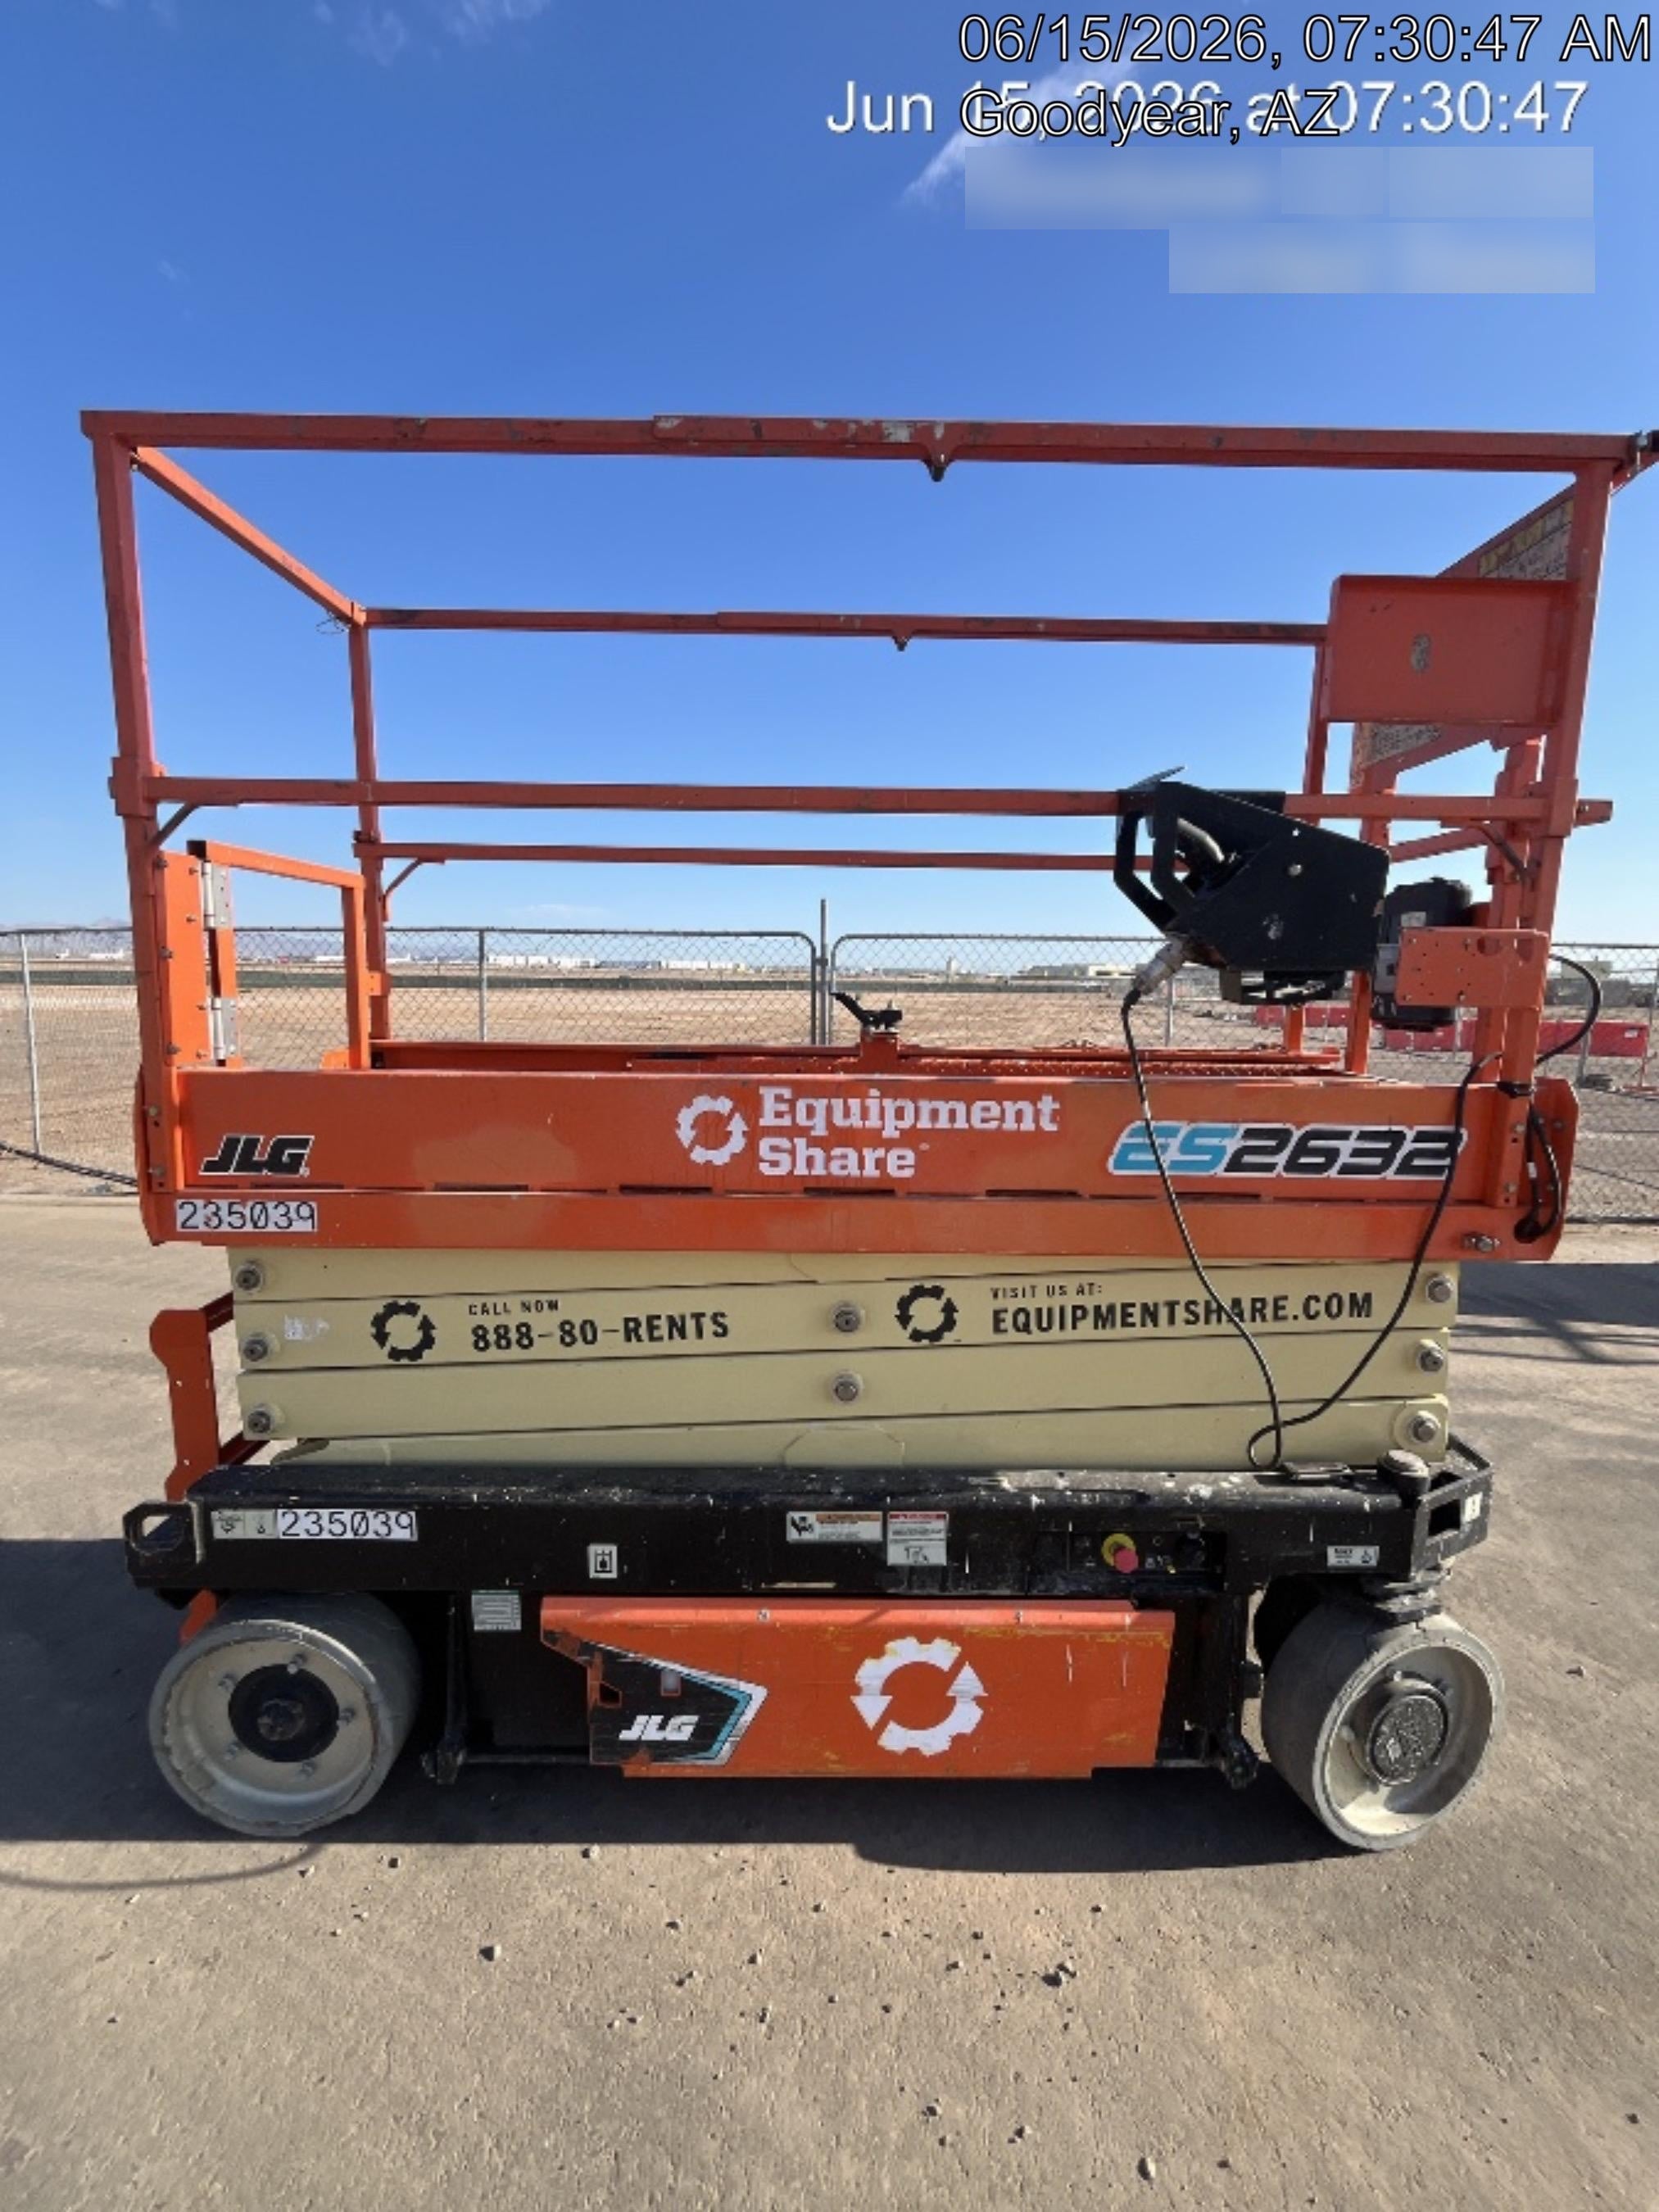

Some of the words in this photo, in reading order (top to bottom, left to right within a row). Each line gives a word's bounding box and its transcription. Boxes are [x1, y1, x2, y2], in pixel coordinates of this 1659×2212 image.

[758, 1086, 1060, 1138] Equipment
[198, 1135, 315, 1177] JLG
[758, 1137, 915, 1178] Share
[1108, 1121, 1467, 1180] ES2632
[178, 1201, 316, 1230] 235039
[469, 1303, 511, 1316] CALL
[520, 1299, 559, 1312] NOW
[990, 1285, 1037, 1299] VISIT
[1046, 1285, 1067, 1298] US
[1076, 1282, 1103, 1296] AT:
[471, 1312, 729, 1352] 888-80-RENTS
[992, 1292, 1373, 1335] EQUIPMENTSHARE.COM
[279, 1510, 418, 1539] 235039
[619, 1714, 699, 1741] JLG
